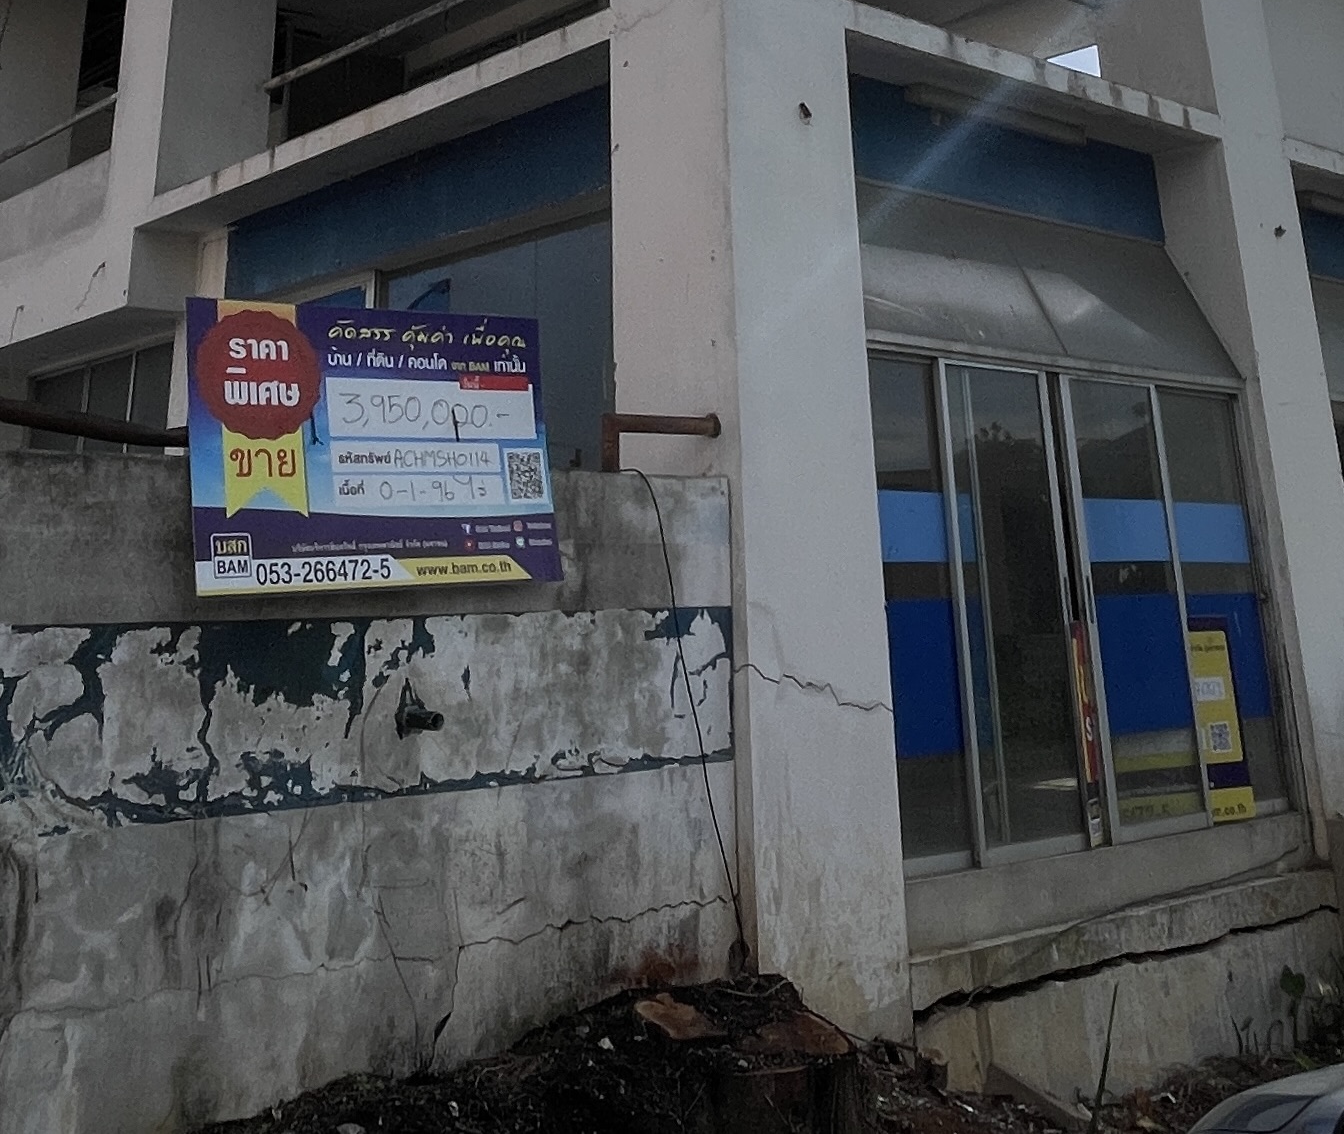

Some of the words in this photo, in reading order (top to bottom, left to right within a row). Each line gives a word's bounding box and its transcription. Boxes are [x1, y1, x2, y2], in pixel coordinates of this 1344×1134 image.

[401, 323, 454, 351] คุ้มค่า
[463, 318, 526, 355] เพื่อคุณ
[227, 338, 290, 361] ราคา
[327, 346, 353, 368] บ้าน
[366, 347, 394, 368] ที่ดิน
[407, 352, 448, 371] คอนโด
[493, 353, 527, 374] เท่านั้น
[224, 366, 301, 407] พิเศษ
[228, 445, 297, 479] ขาย
[338, 449, 392, 465] รหัสทรัพย์
[338, 478, 366, 497] เนื้อที่
[214, 538, 248, 555] บสก
[217, 559, 249, 575] BAM
[256, 558, 392, 585] 053-266472-5
[416, 561, 513, 577] www.bam.co.th
